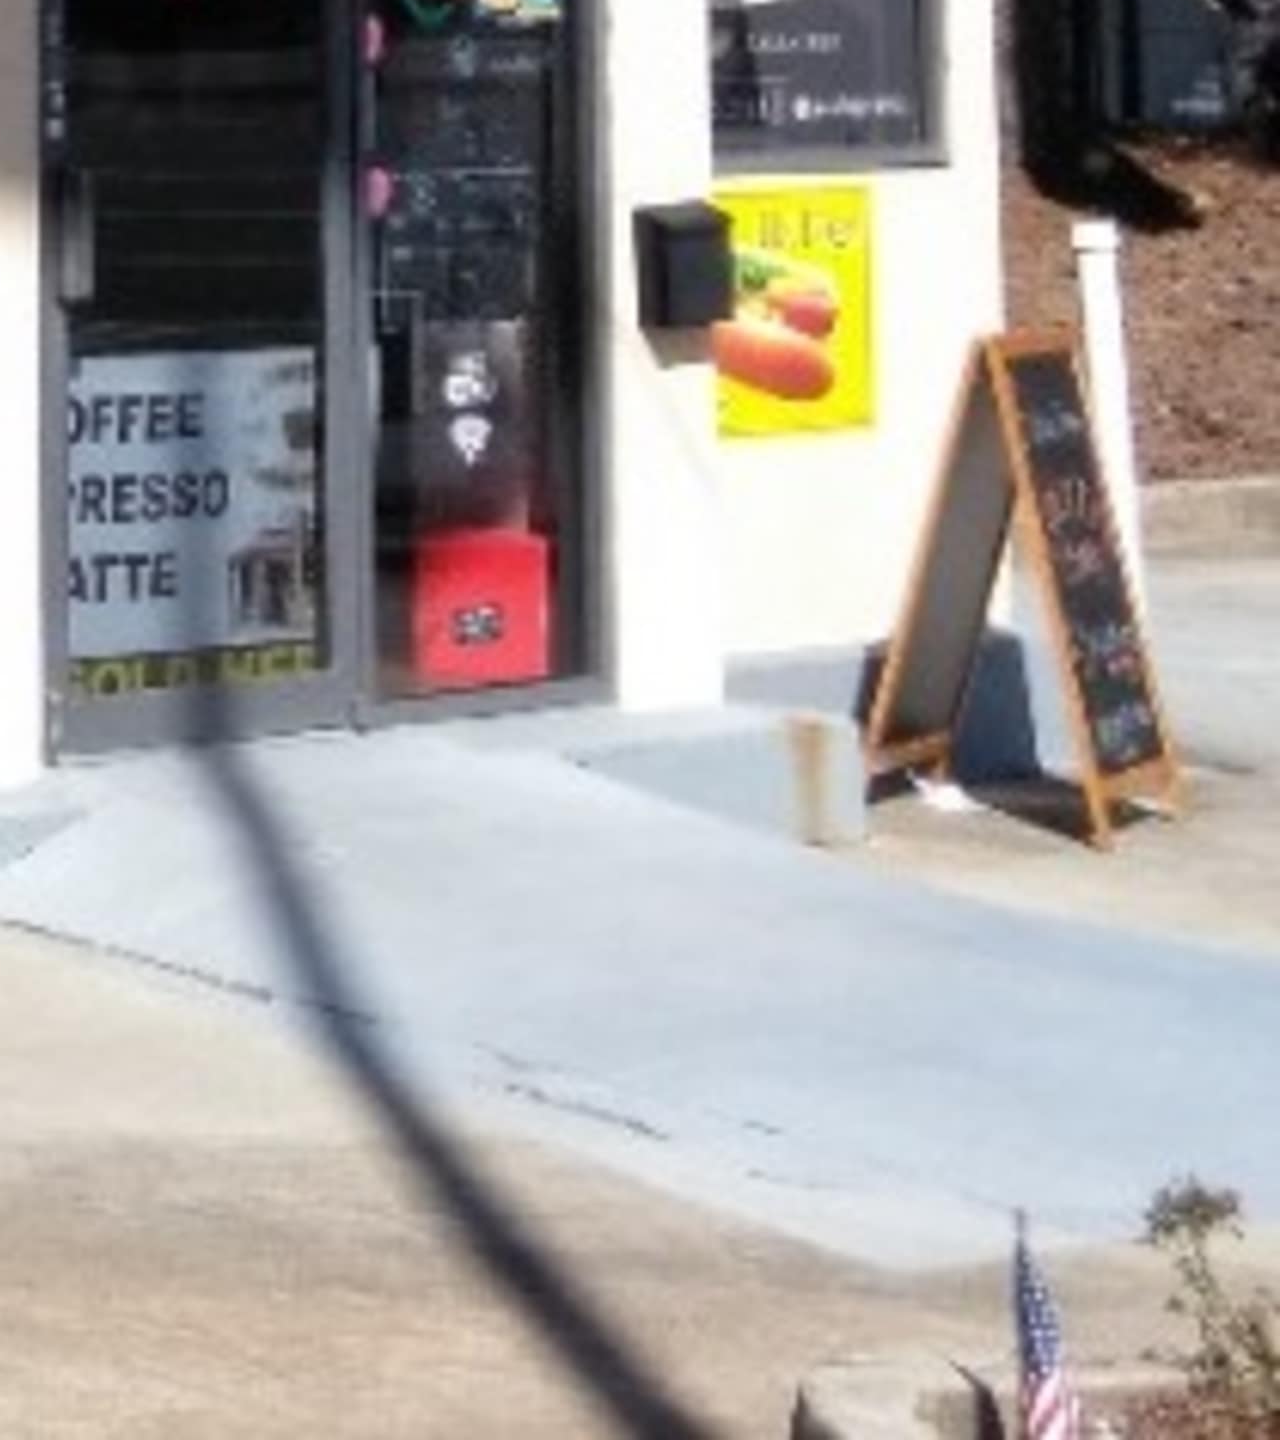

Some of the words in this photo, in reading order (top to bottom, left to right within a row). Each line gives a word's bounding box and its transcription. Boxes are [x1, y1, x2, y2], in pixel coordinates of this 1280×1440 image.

[68, 392, 205, 445] OFFEE
[70, 469, 230, 524] RESSO
[68, 552, 180, 603] ATTE
